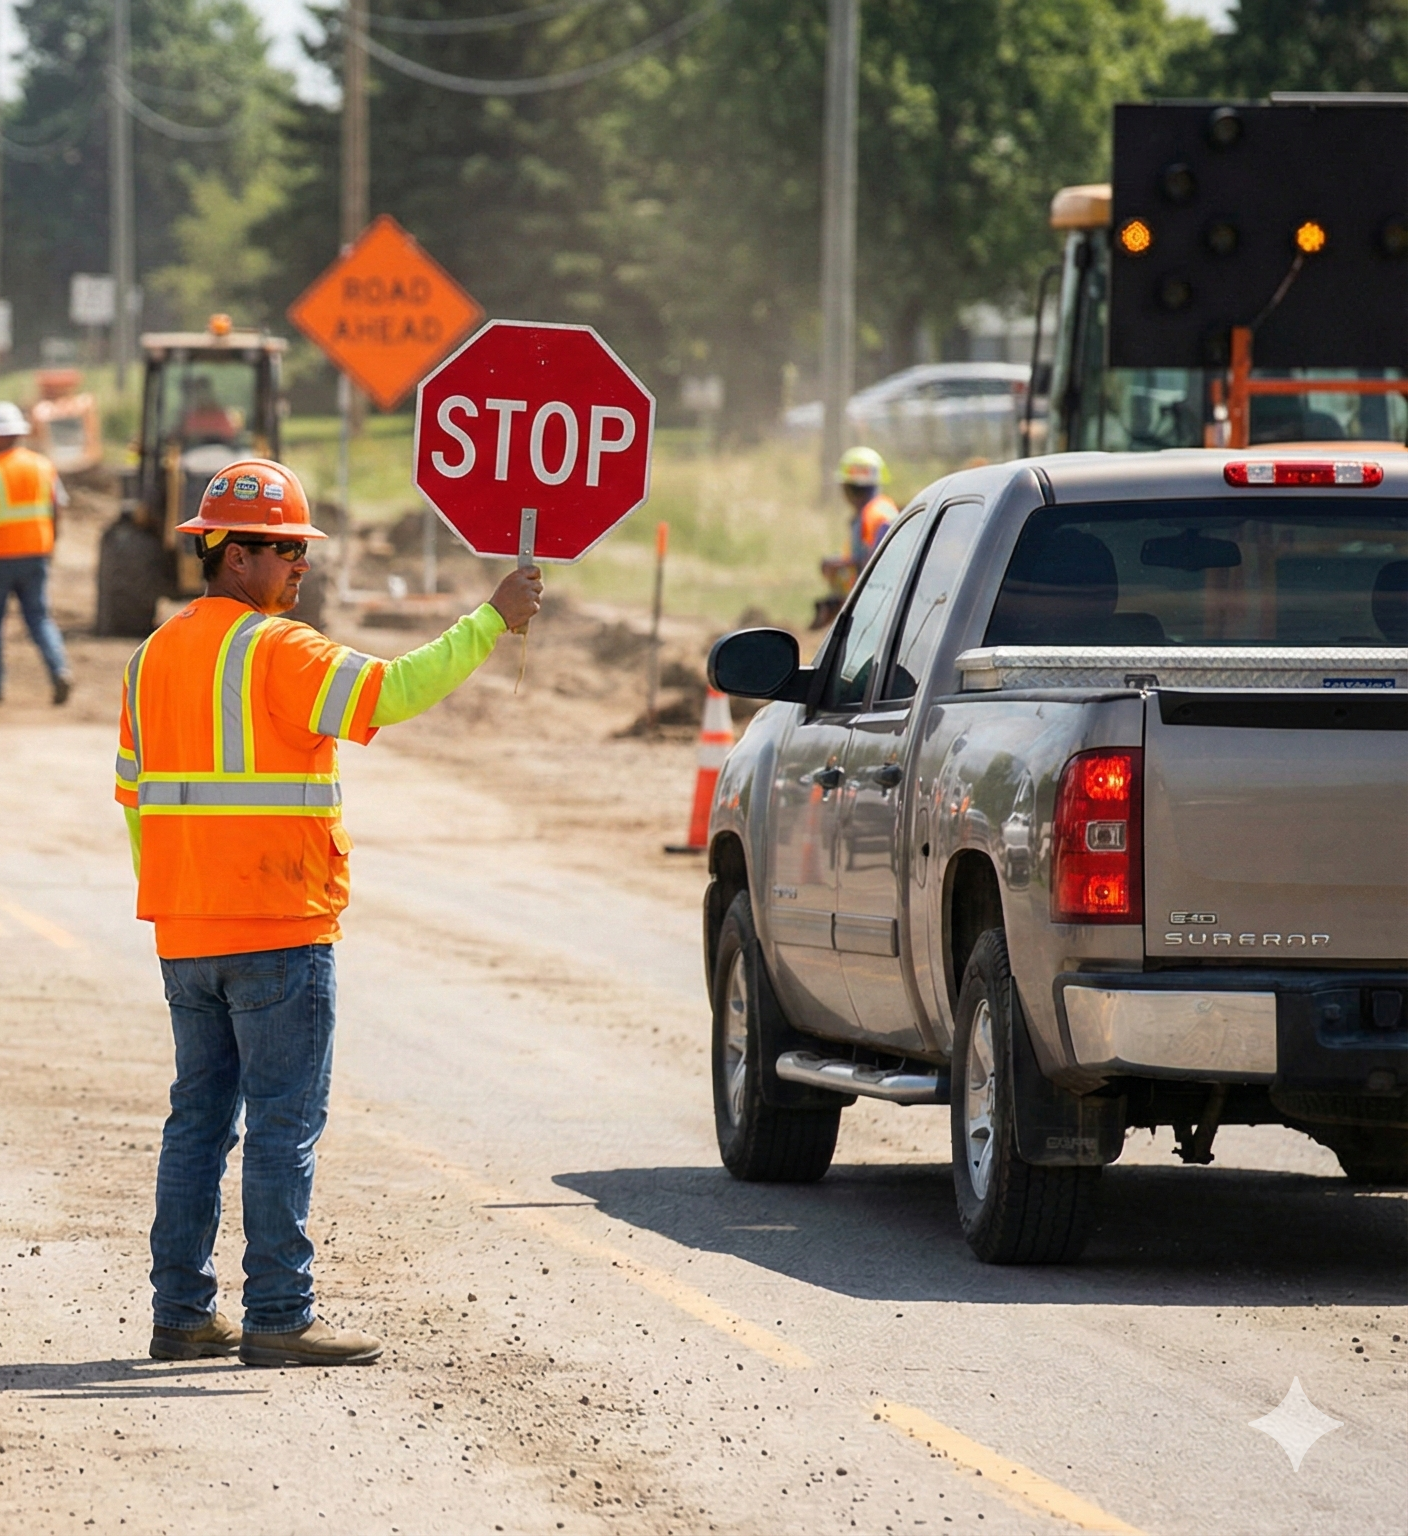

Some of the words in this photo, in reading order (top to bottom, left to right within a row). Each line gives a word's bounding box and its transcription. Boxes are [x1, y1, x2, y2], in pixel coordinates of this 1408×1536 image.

[342, 275, 432, 306] ROAD
[332, 315, 444, 345] AHEAD
[431, 394, 636, 487] STOP
